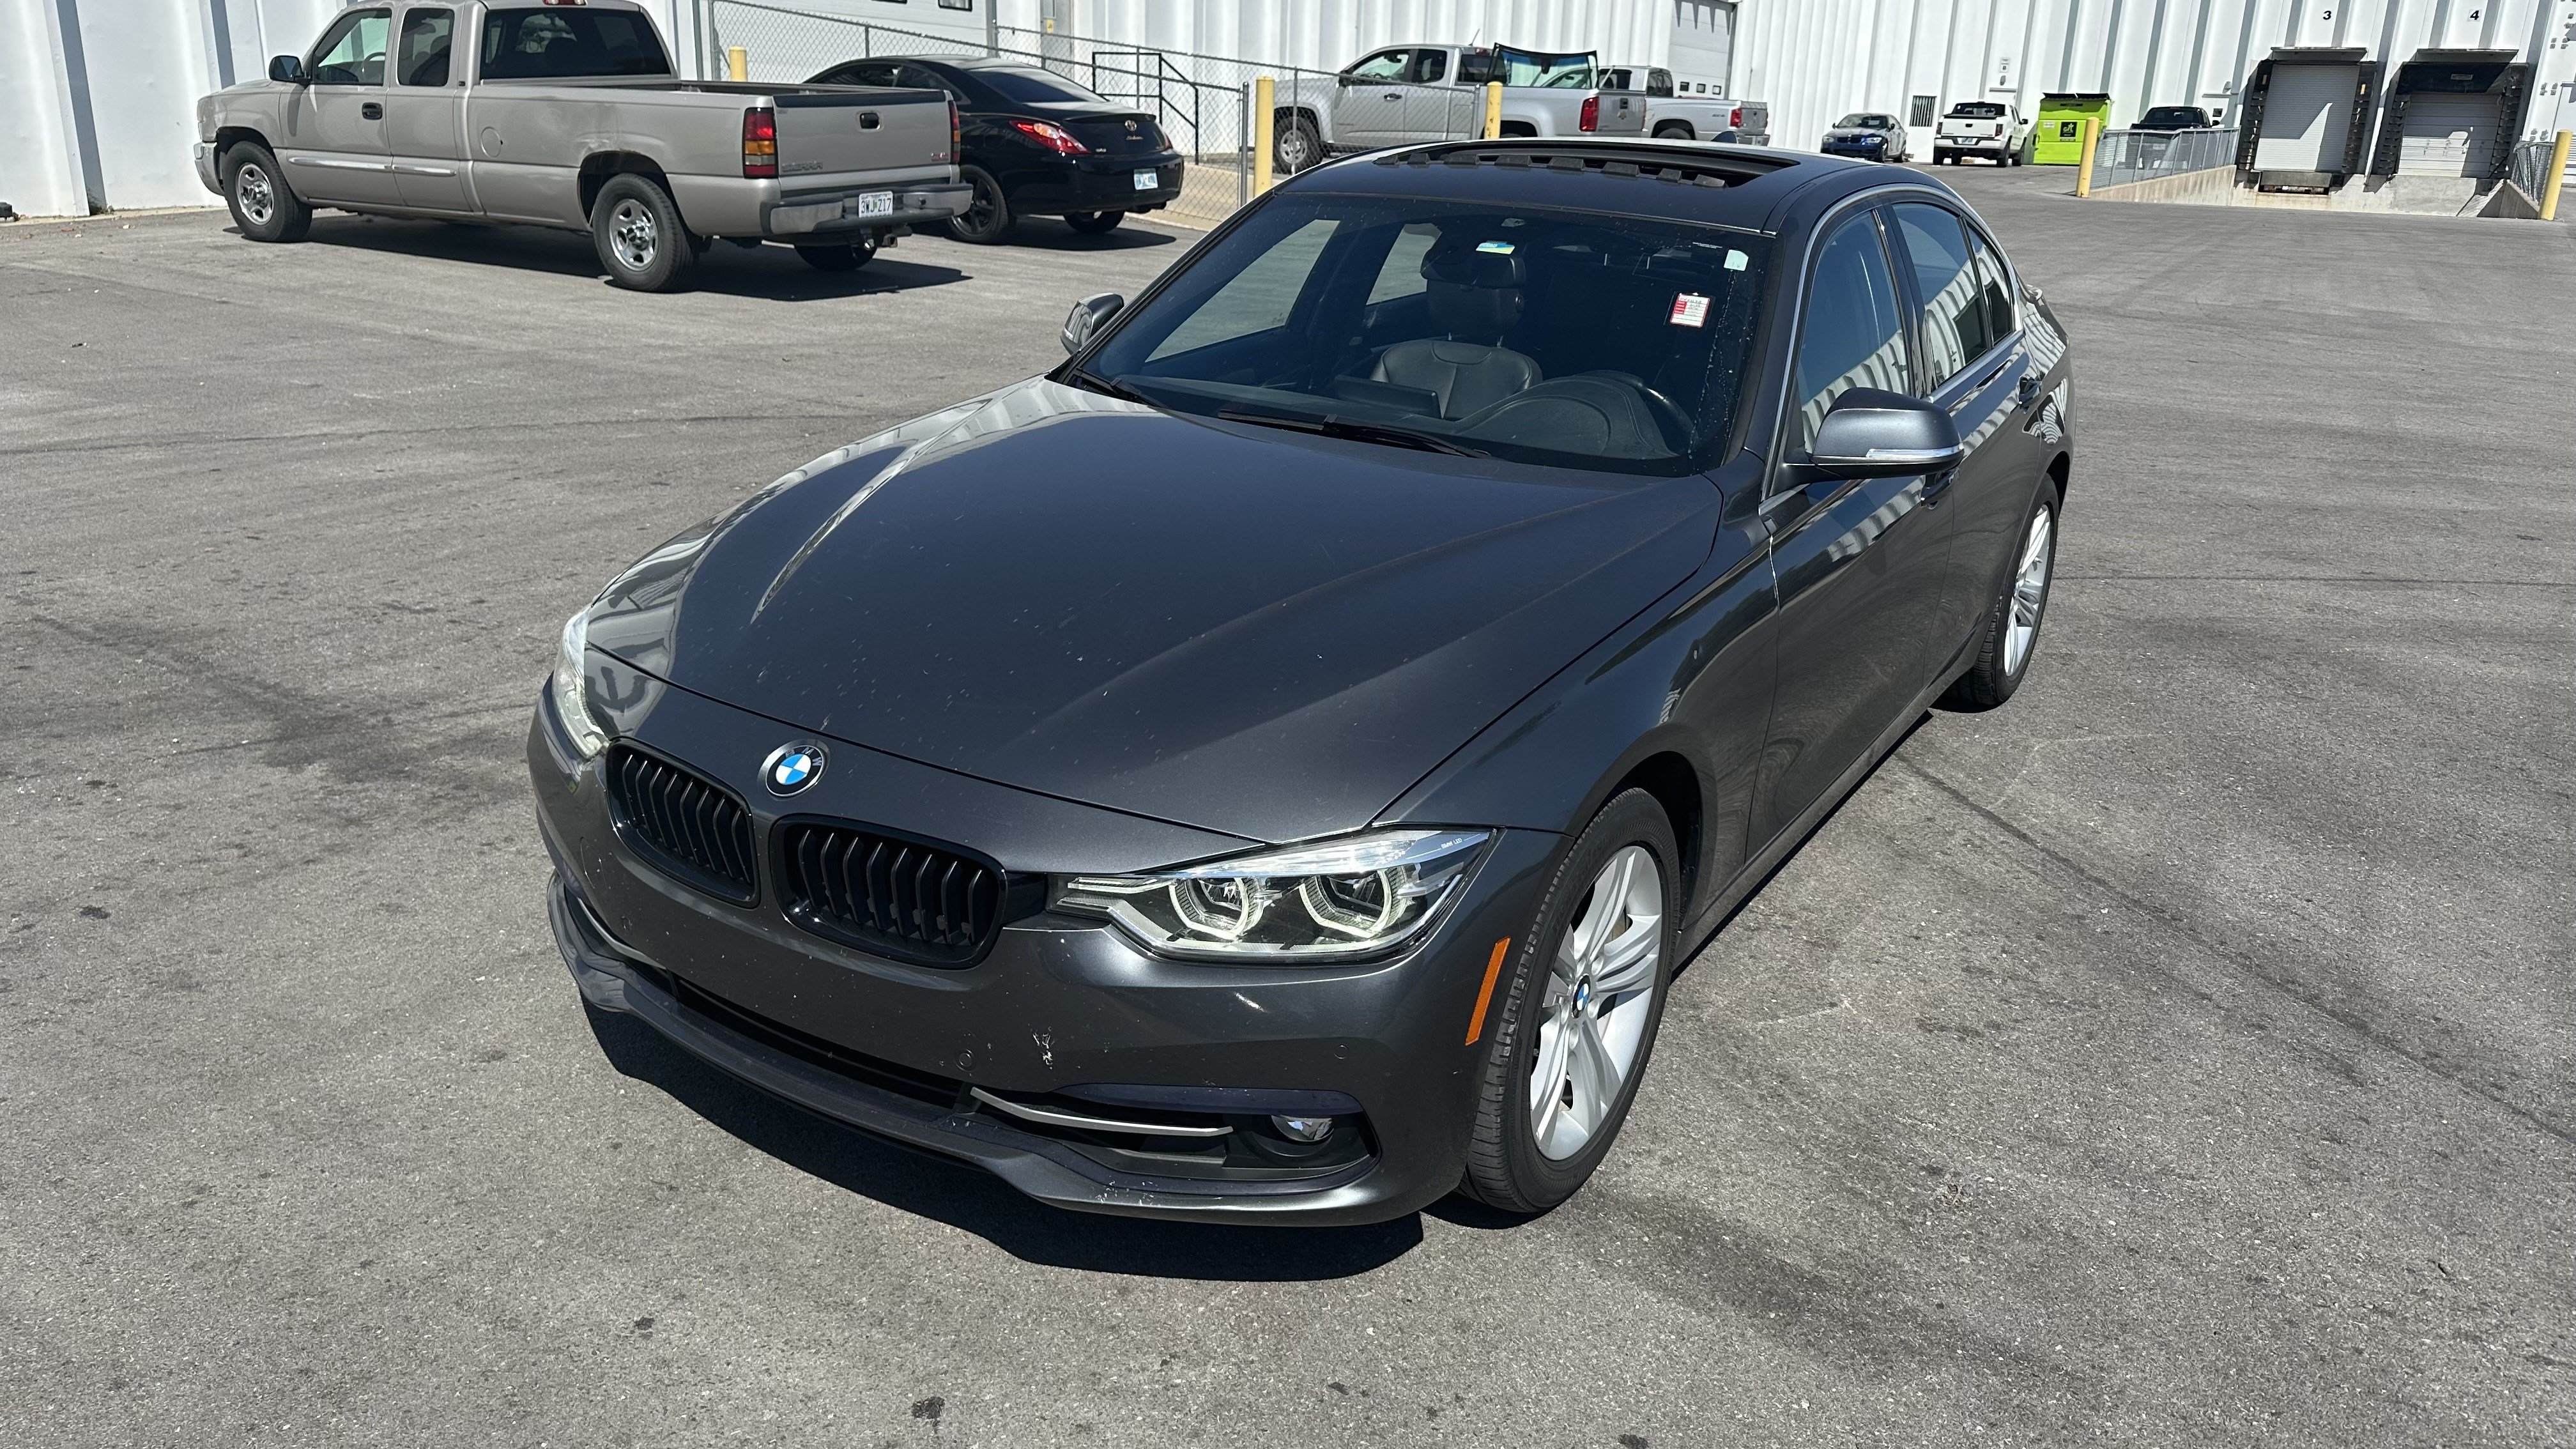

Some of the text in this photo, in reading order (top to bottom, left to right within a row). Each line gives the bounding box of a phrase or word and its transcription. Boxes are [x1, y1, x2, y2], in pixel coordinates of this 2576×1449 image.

[2323, 10, 2332, 20] 3
[2470, 10, 2480, 20] 4
[785, 746, 823, 766] BMW
[1440, 840, 1453, 849] BMW
